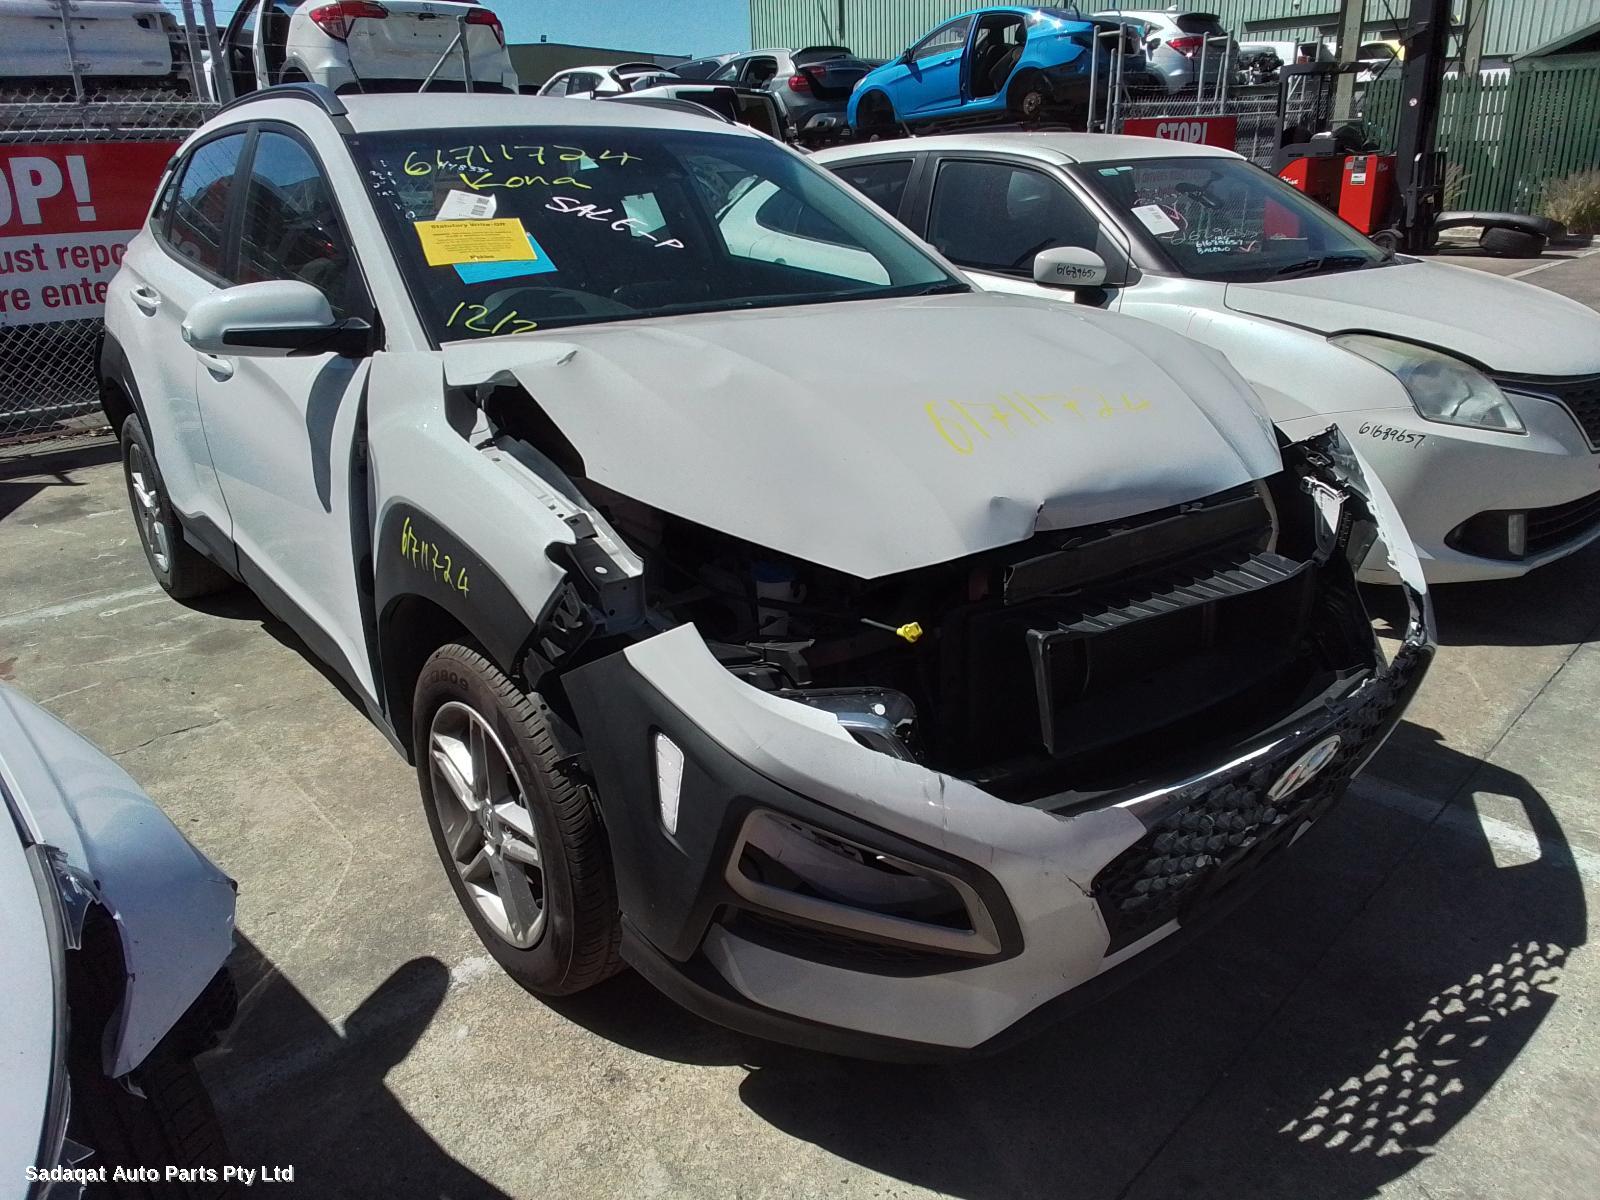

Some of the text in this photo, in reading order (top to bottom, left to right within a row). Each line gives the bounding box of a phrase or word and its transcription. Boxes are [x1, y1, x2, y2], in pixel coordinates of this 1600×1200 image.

[459, 171, 593, 190] Kona
[1056, 263, 1097, 280] 61689657
[1358, 421, 1426, 449] 61689657
